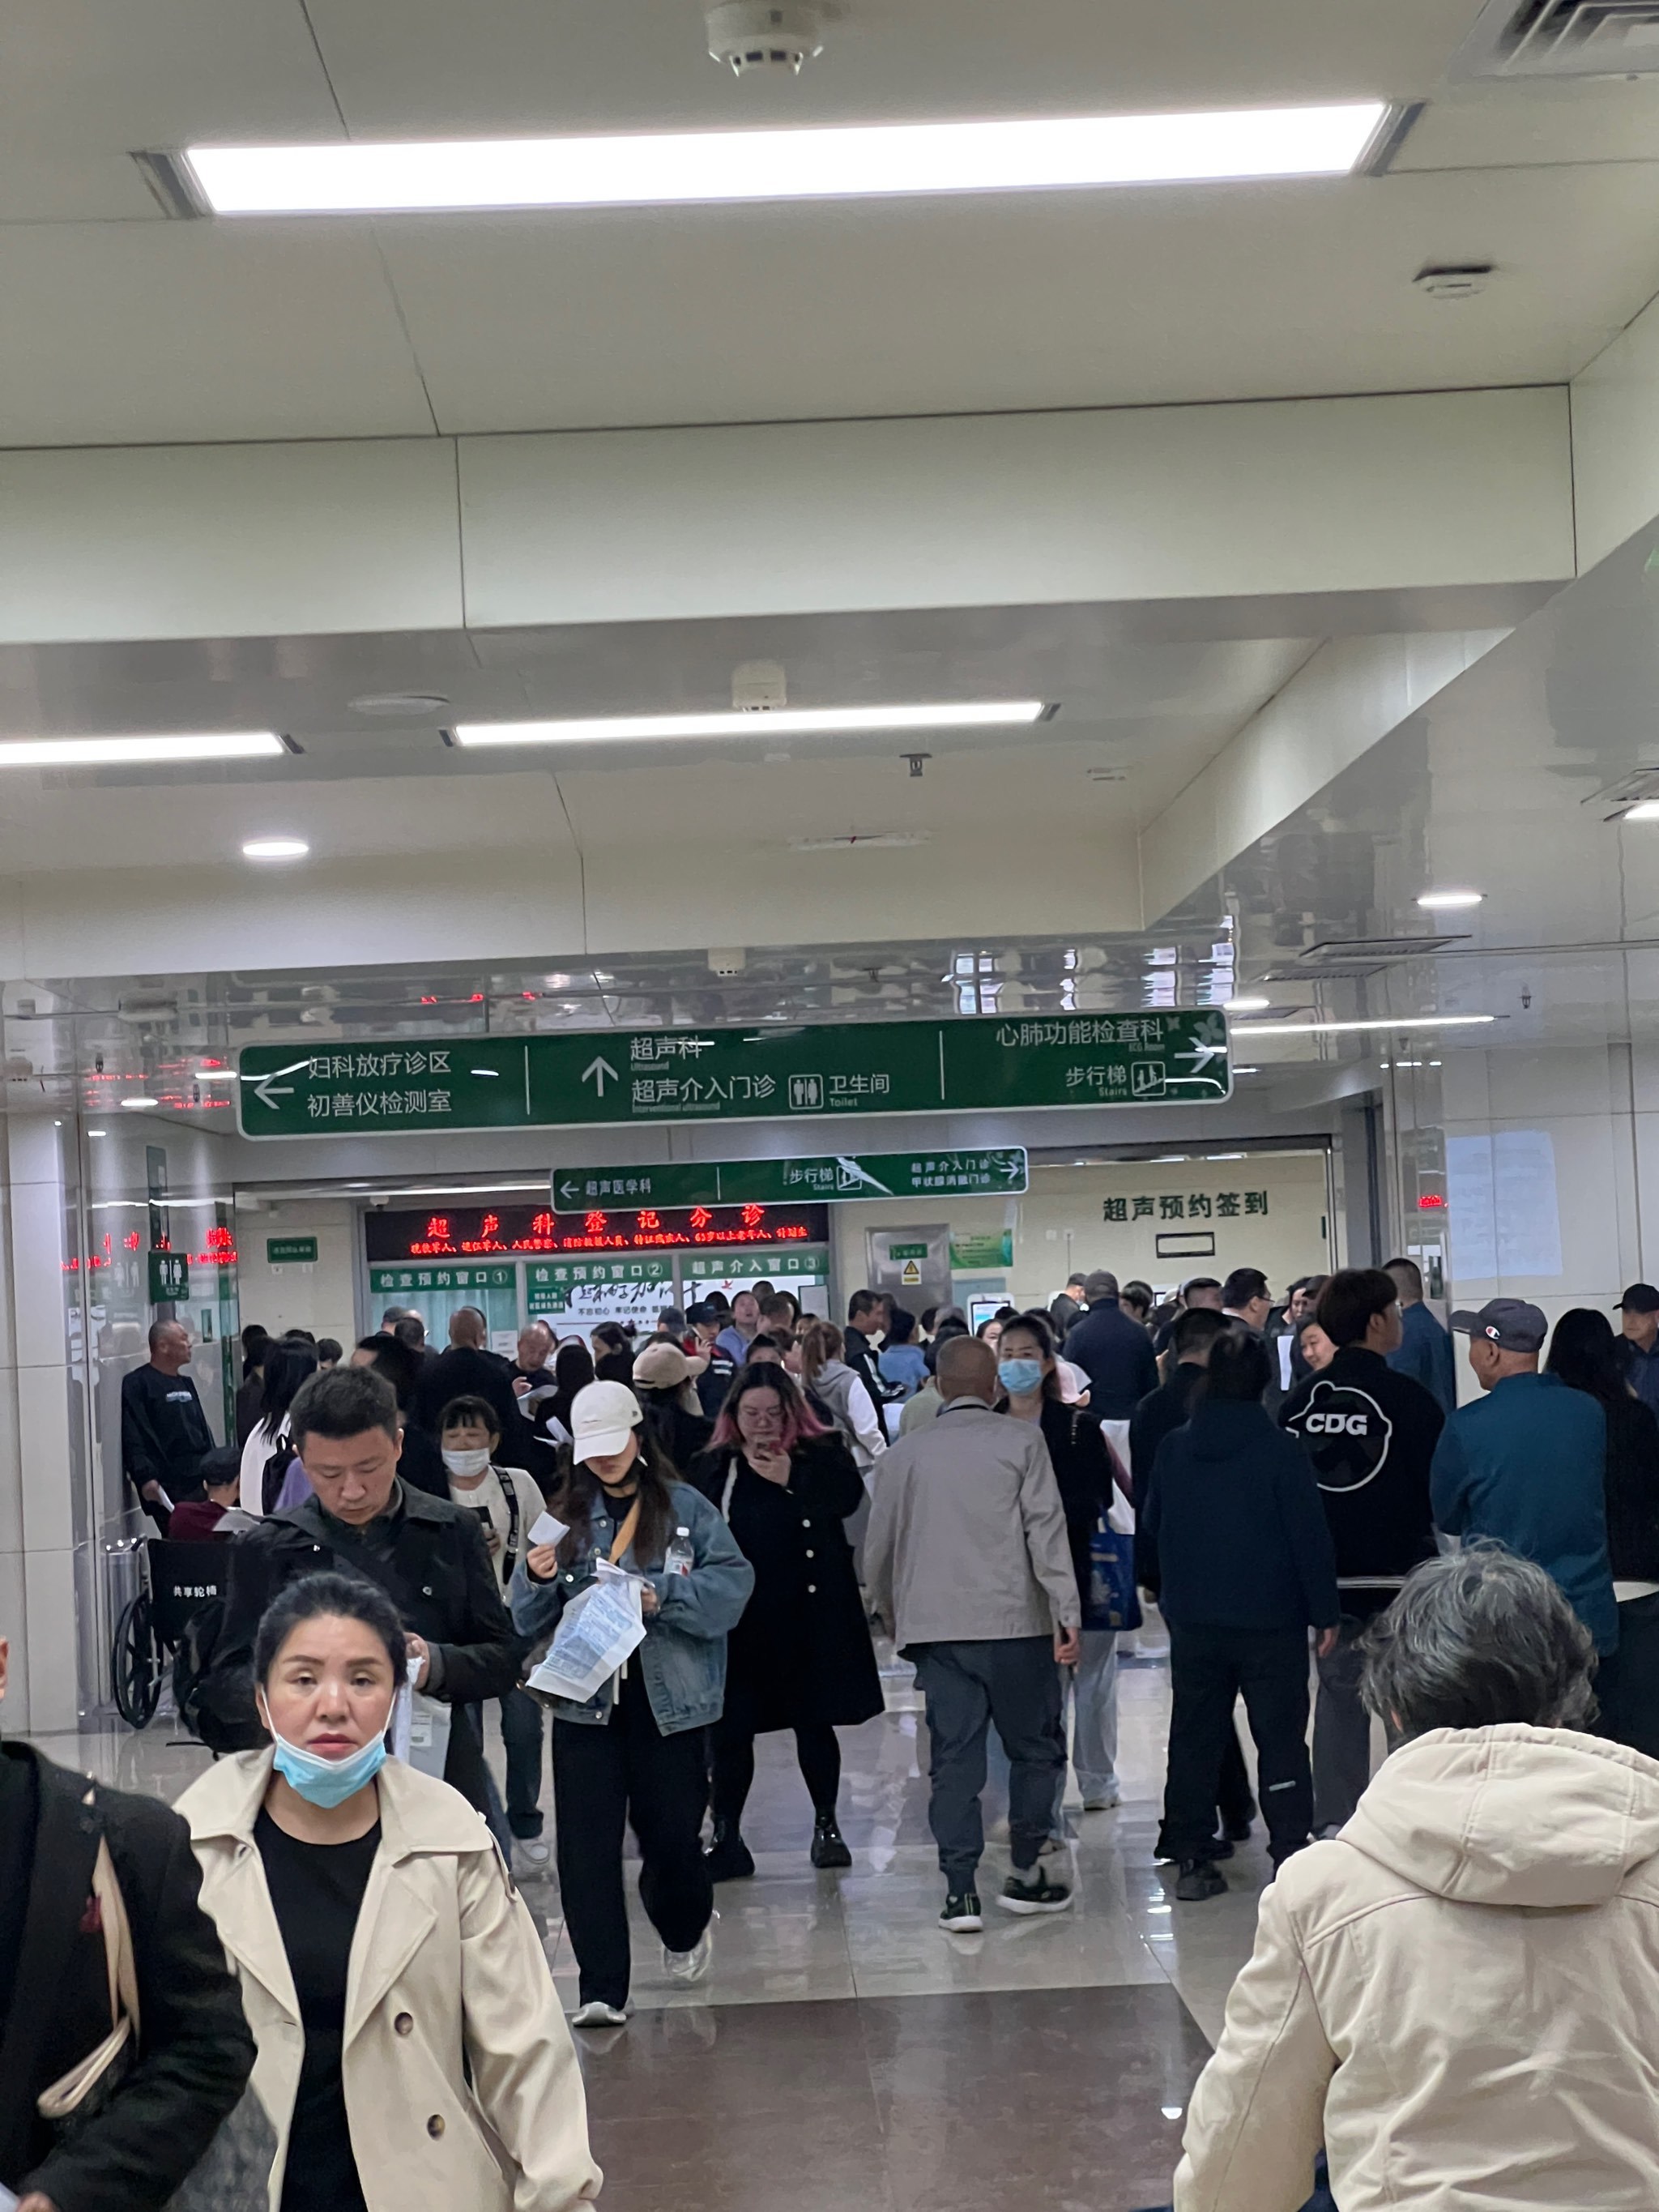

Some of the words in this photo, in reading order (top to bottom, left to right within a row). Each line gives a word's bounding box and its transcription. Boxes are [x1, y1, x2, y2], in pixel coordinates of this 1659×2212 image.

[996, 1018, 1164, 1047] 心肺功能检查科
[630, 1035, 702, 1061] 超声科
[309, 1051, 451, 1079] 妇科放疗诊区
[1065, 1064, 1127, 1087] 步行梯
[631, 1074, 776, 1103] 超声介入门诊
[829, 1073, 890, 1094] 卫生间
[307, 1090, 452, 1117] 初善仪检测室
[829, 1097, 858, 1107] Toilet
[586, 1177, 651, 1197] 超声医学科
[789, 1167, 834, 1184] 步行梯
[1102, 1190, 1269, 1222] 超声预约签到
[427, 1203, 766, 1238] 超声科登记分诊
[1305, 1413, 1368, 1436] CDG
